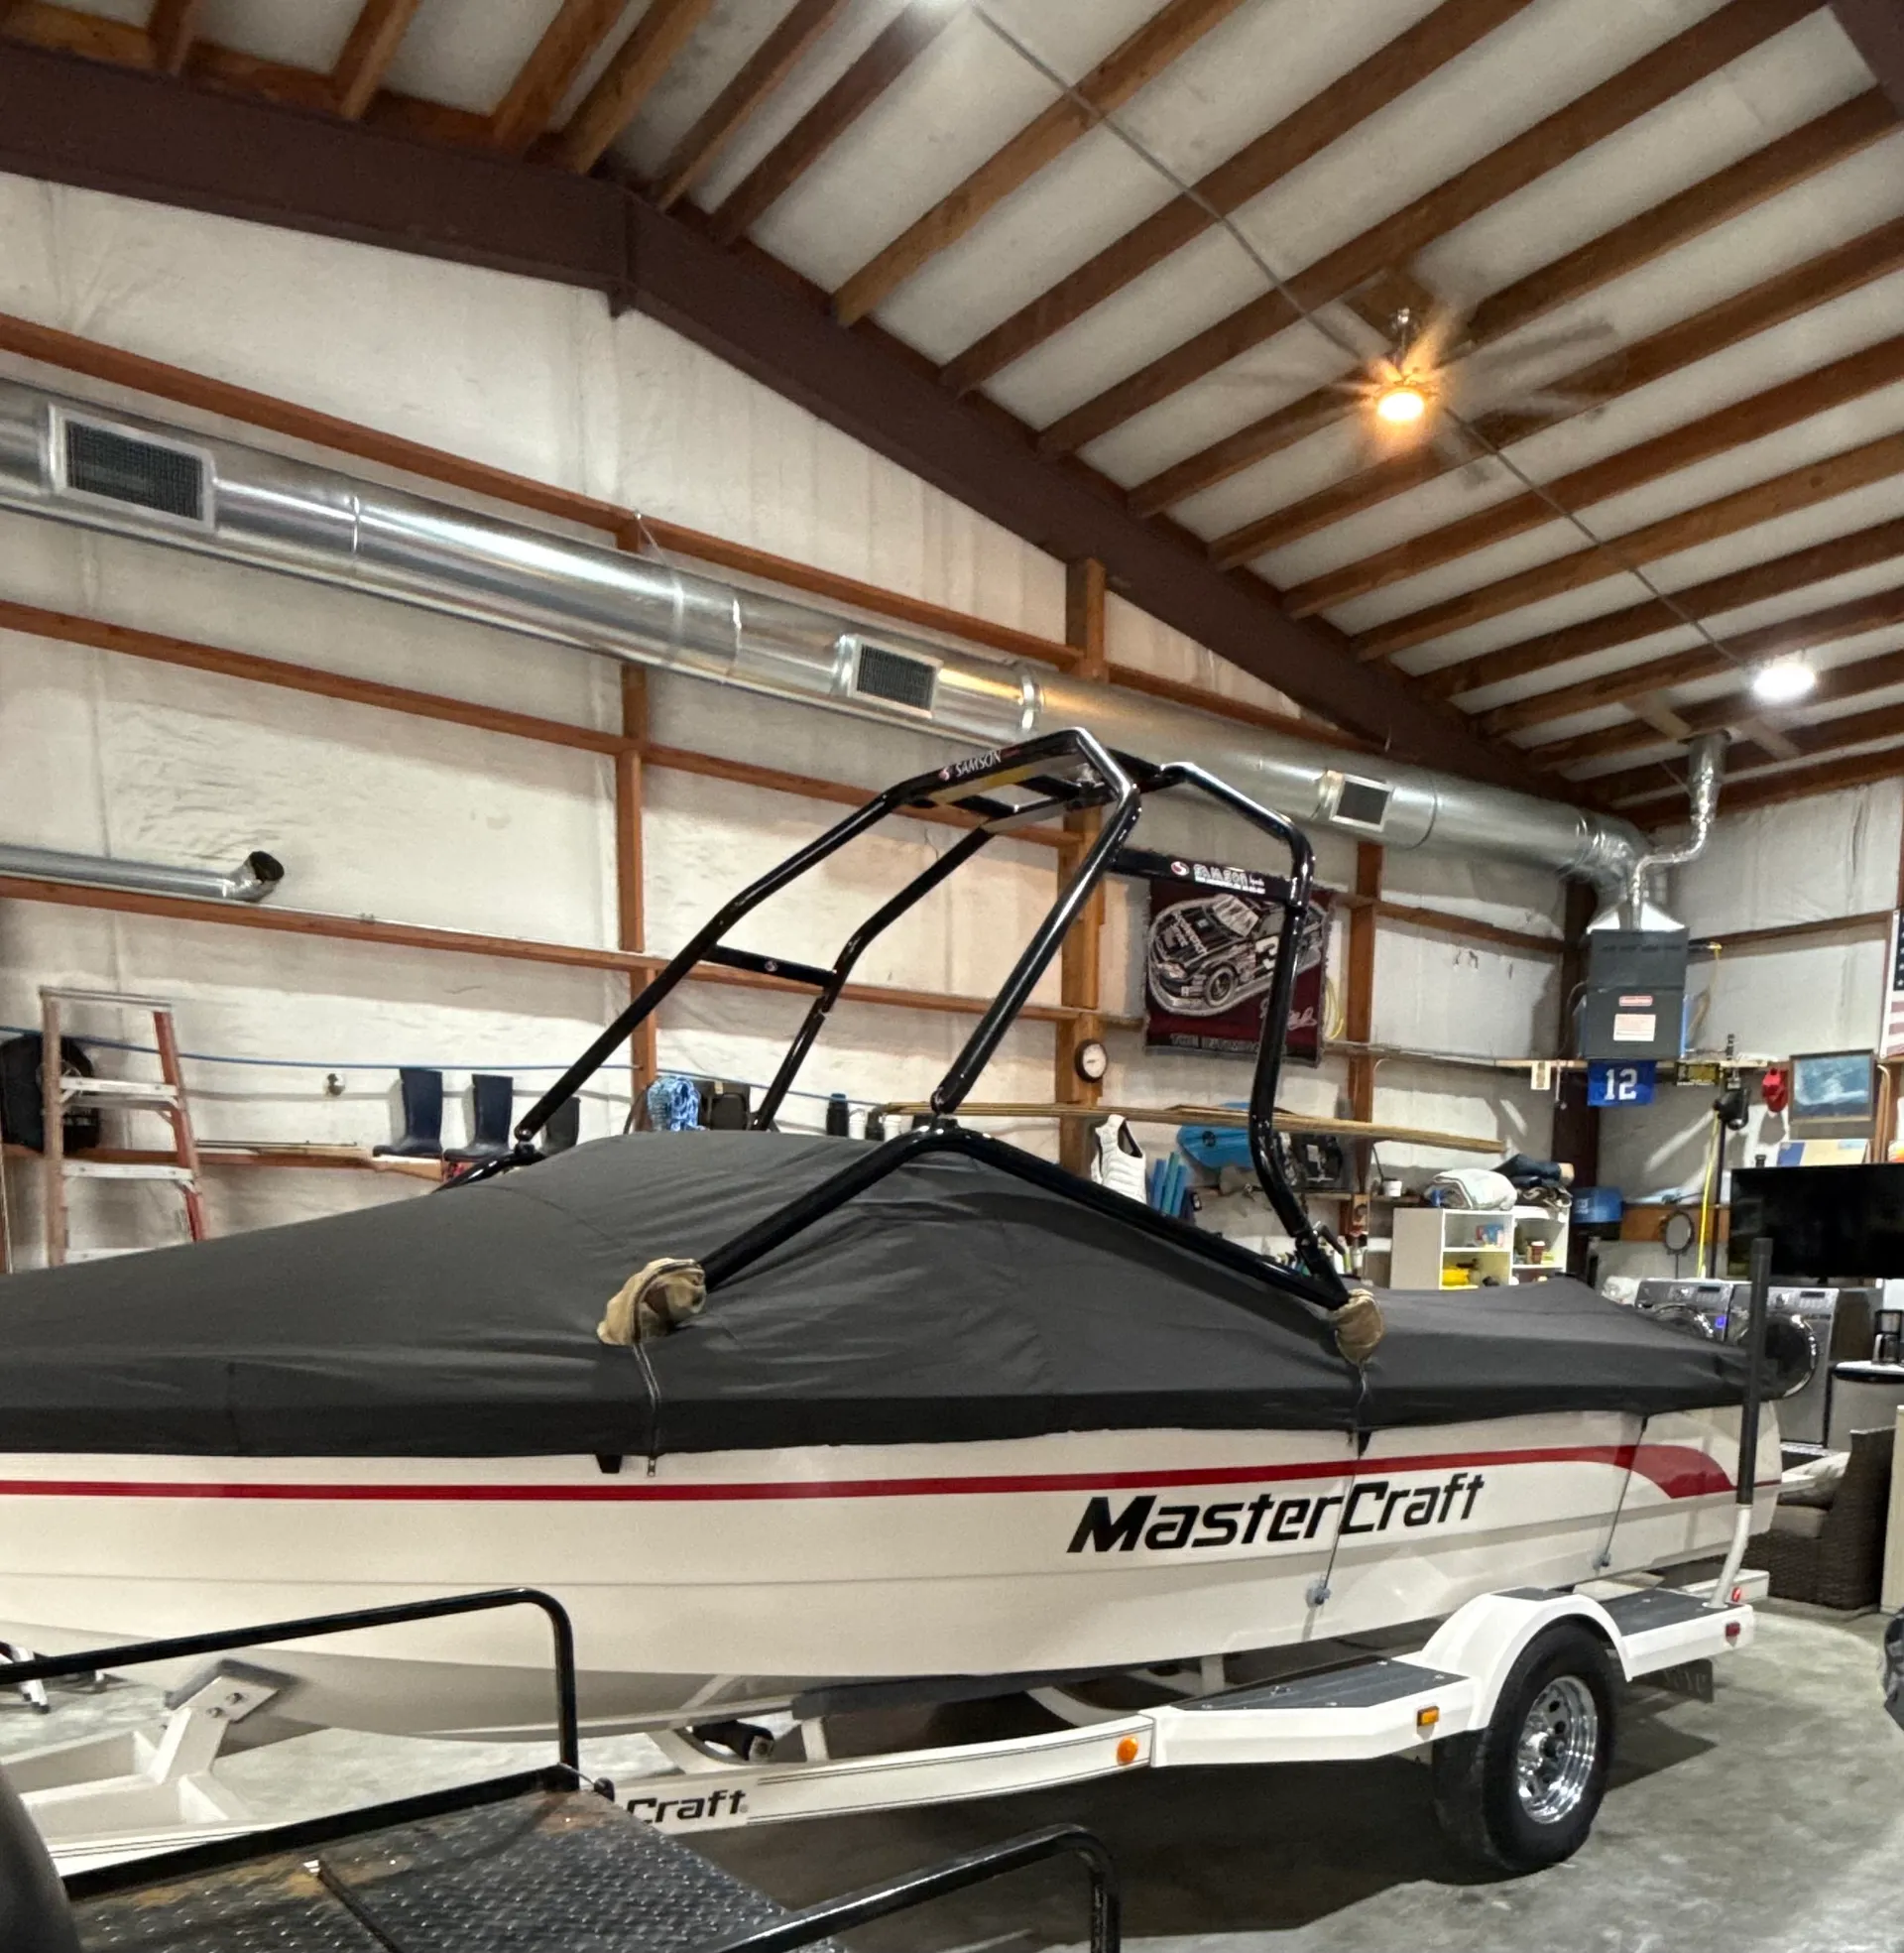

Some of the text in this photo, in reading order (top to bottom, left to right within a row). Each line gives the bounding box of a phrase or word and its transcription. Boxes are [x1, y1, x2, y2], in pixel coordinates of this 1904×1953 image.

[955, 750, 1002, 778] SAMSON
[1604, 1067, 1637, 1100] 12
[1066, 1472, 1485, 1553] MasterCraft
